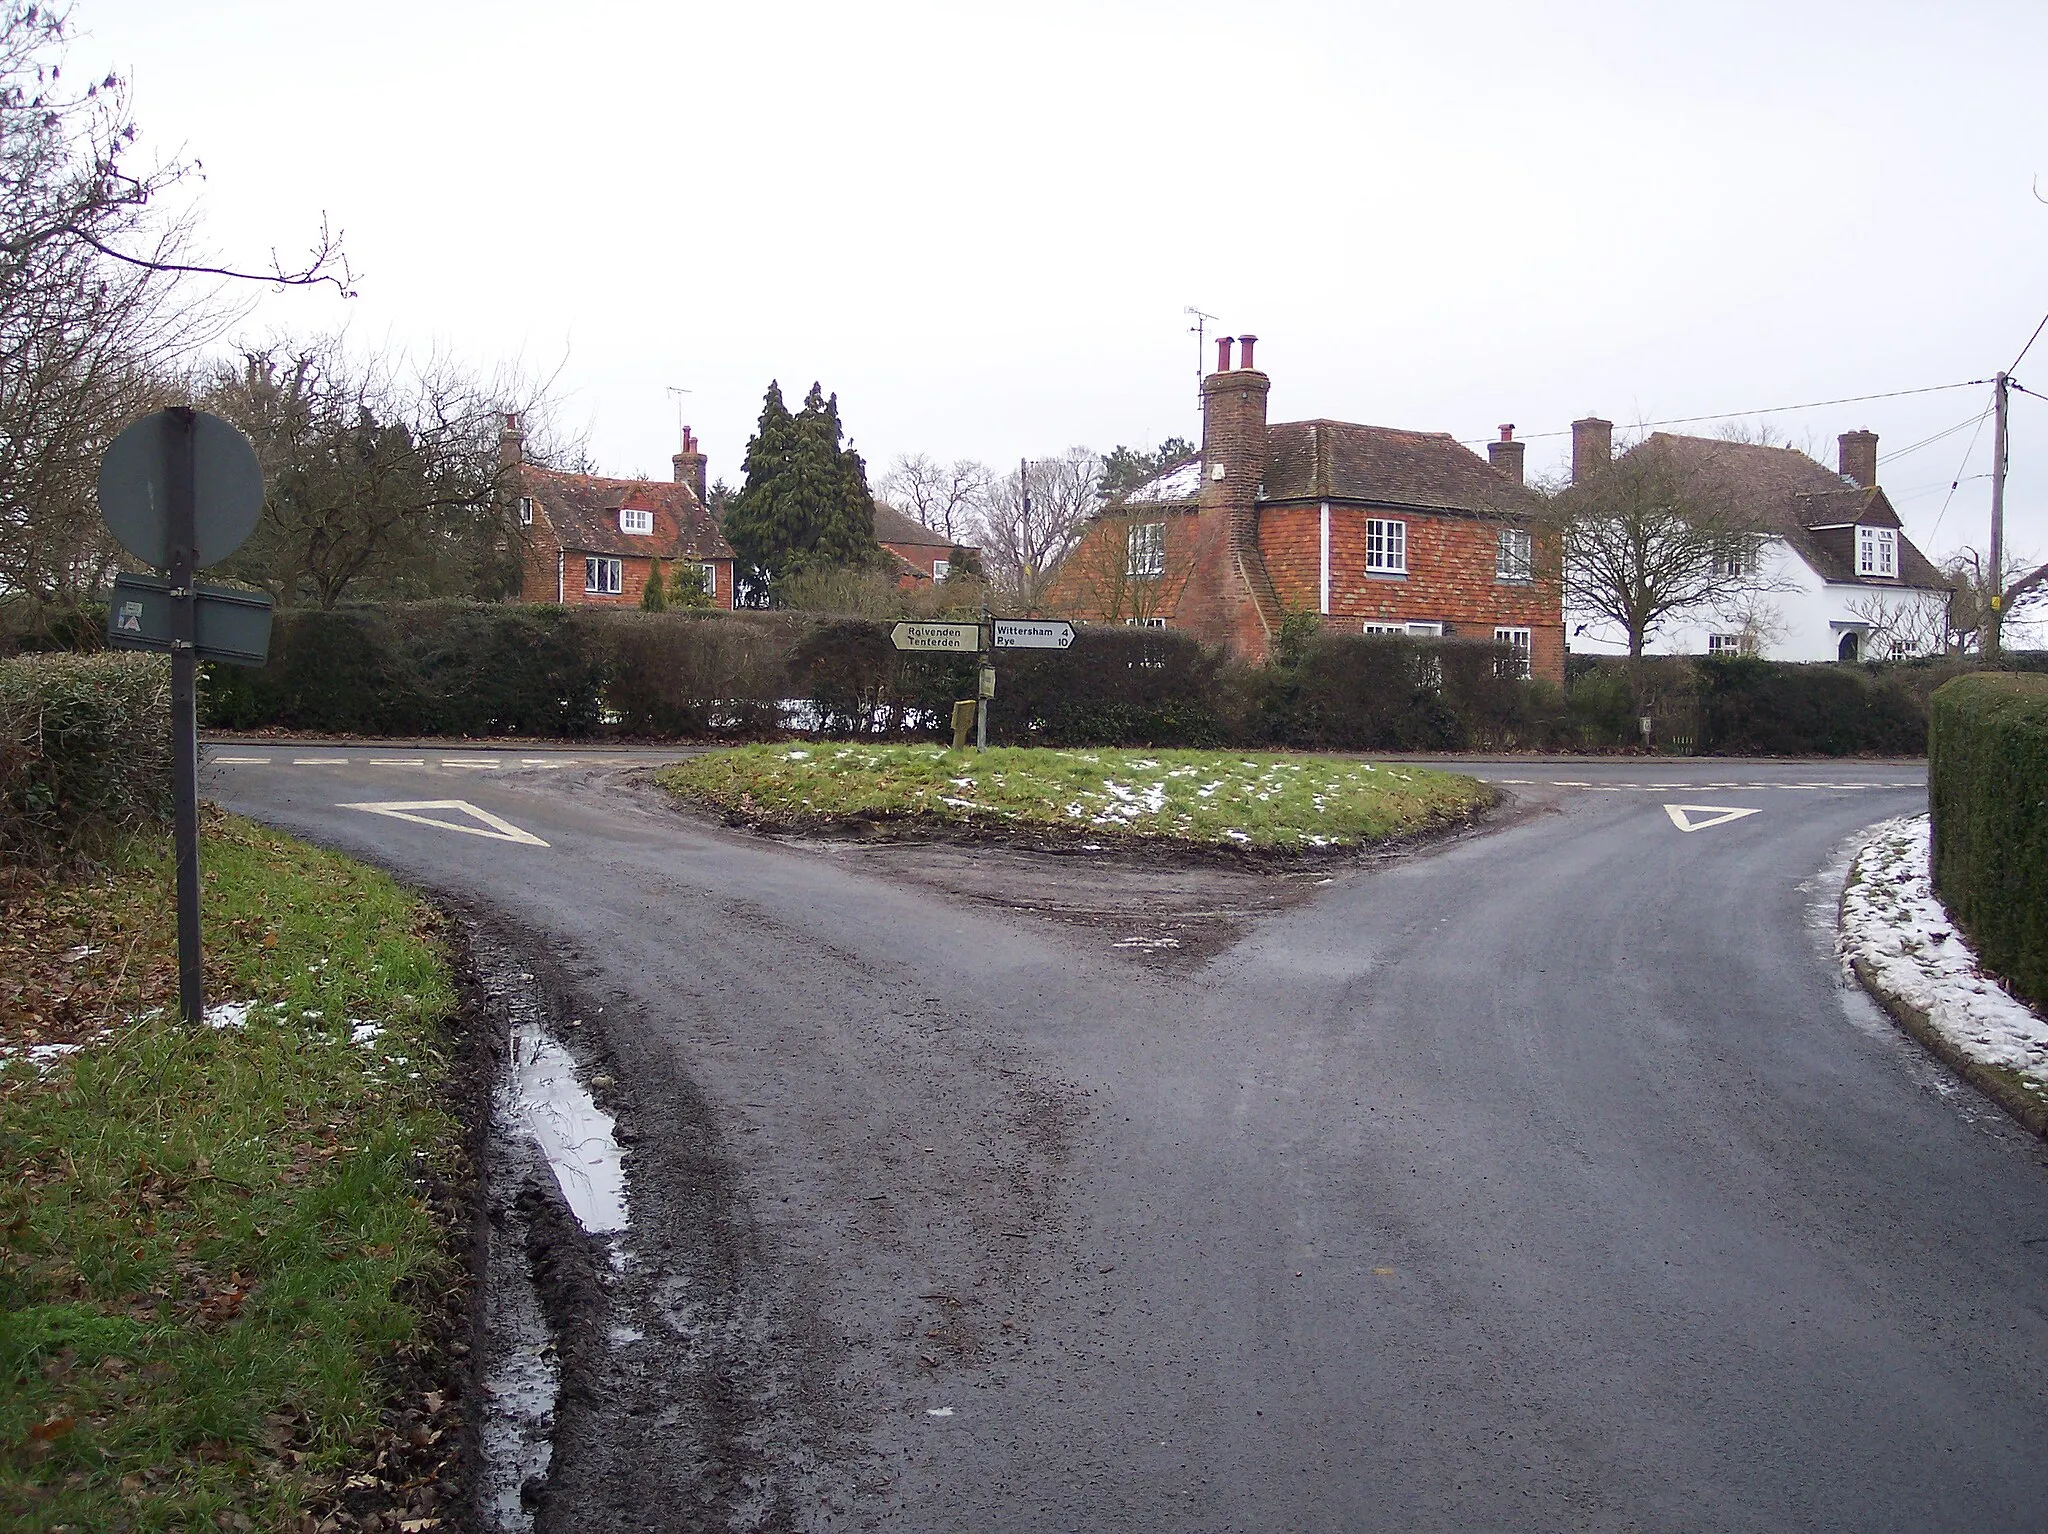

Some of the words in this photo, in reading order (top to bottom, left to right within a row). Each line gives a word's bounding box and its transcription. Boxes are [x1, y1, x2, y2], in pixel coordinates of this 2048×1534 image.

[908, 627, 961, 637] Rolvenden
[997, 626, 1053, 636] Wittersham
[1062, 628, 1068, 637] 4
[907, 636, 960, 647] Tenterden
[997, 637, 1015, 646] Rye
[1058, 638, 1068, 647] 10
